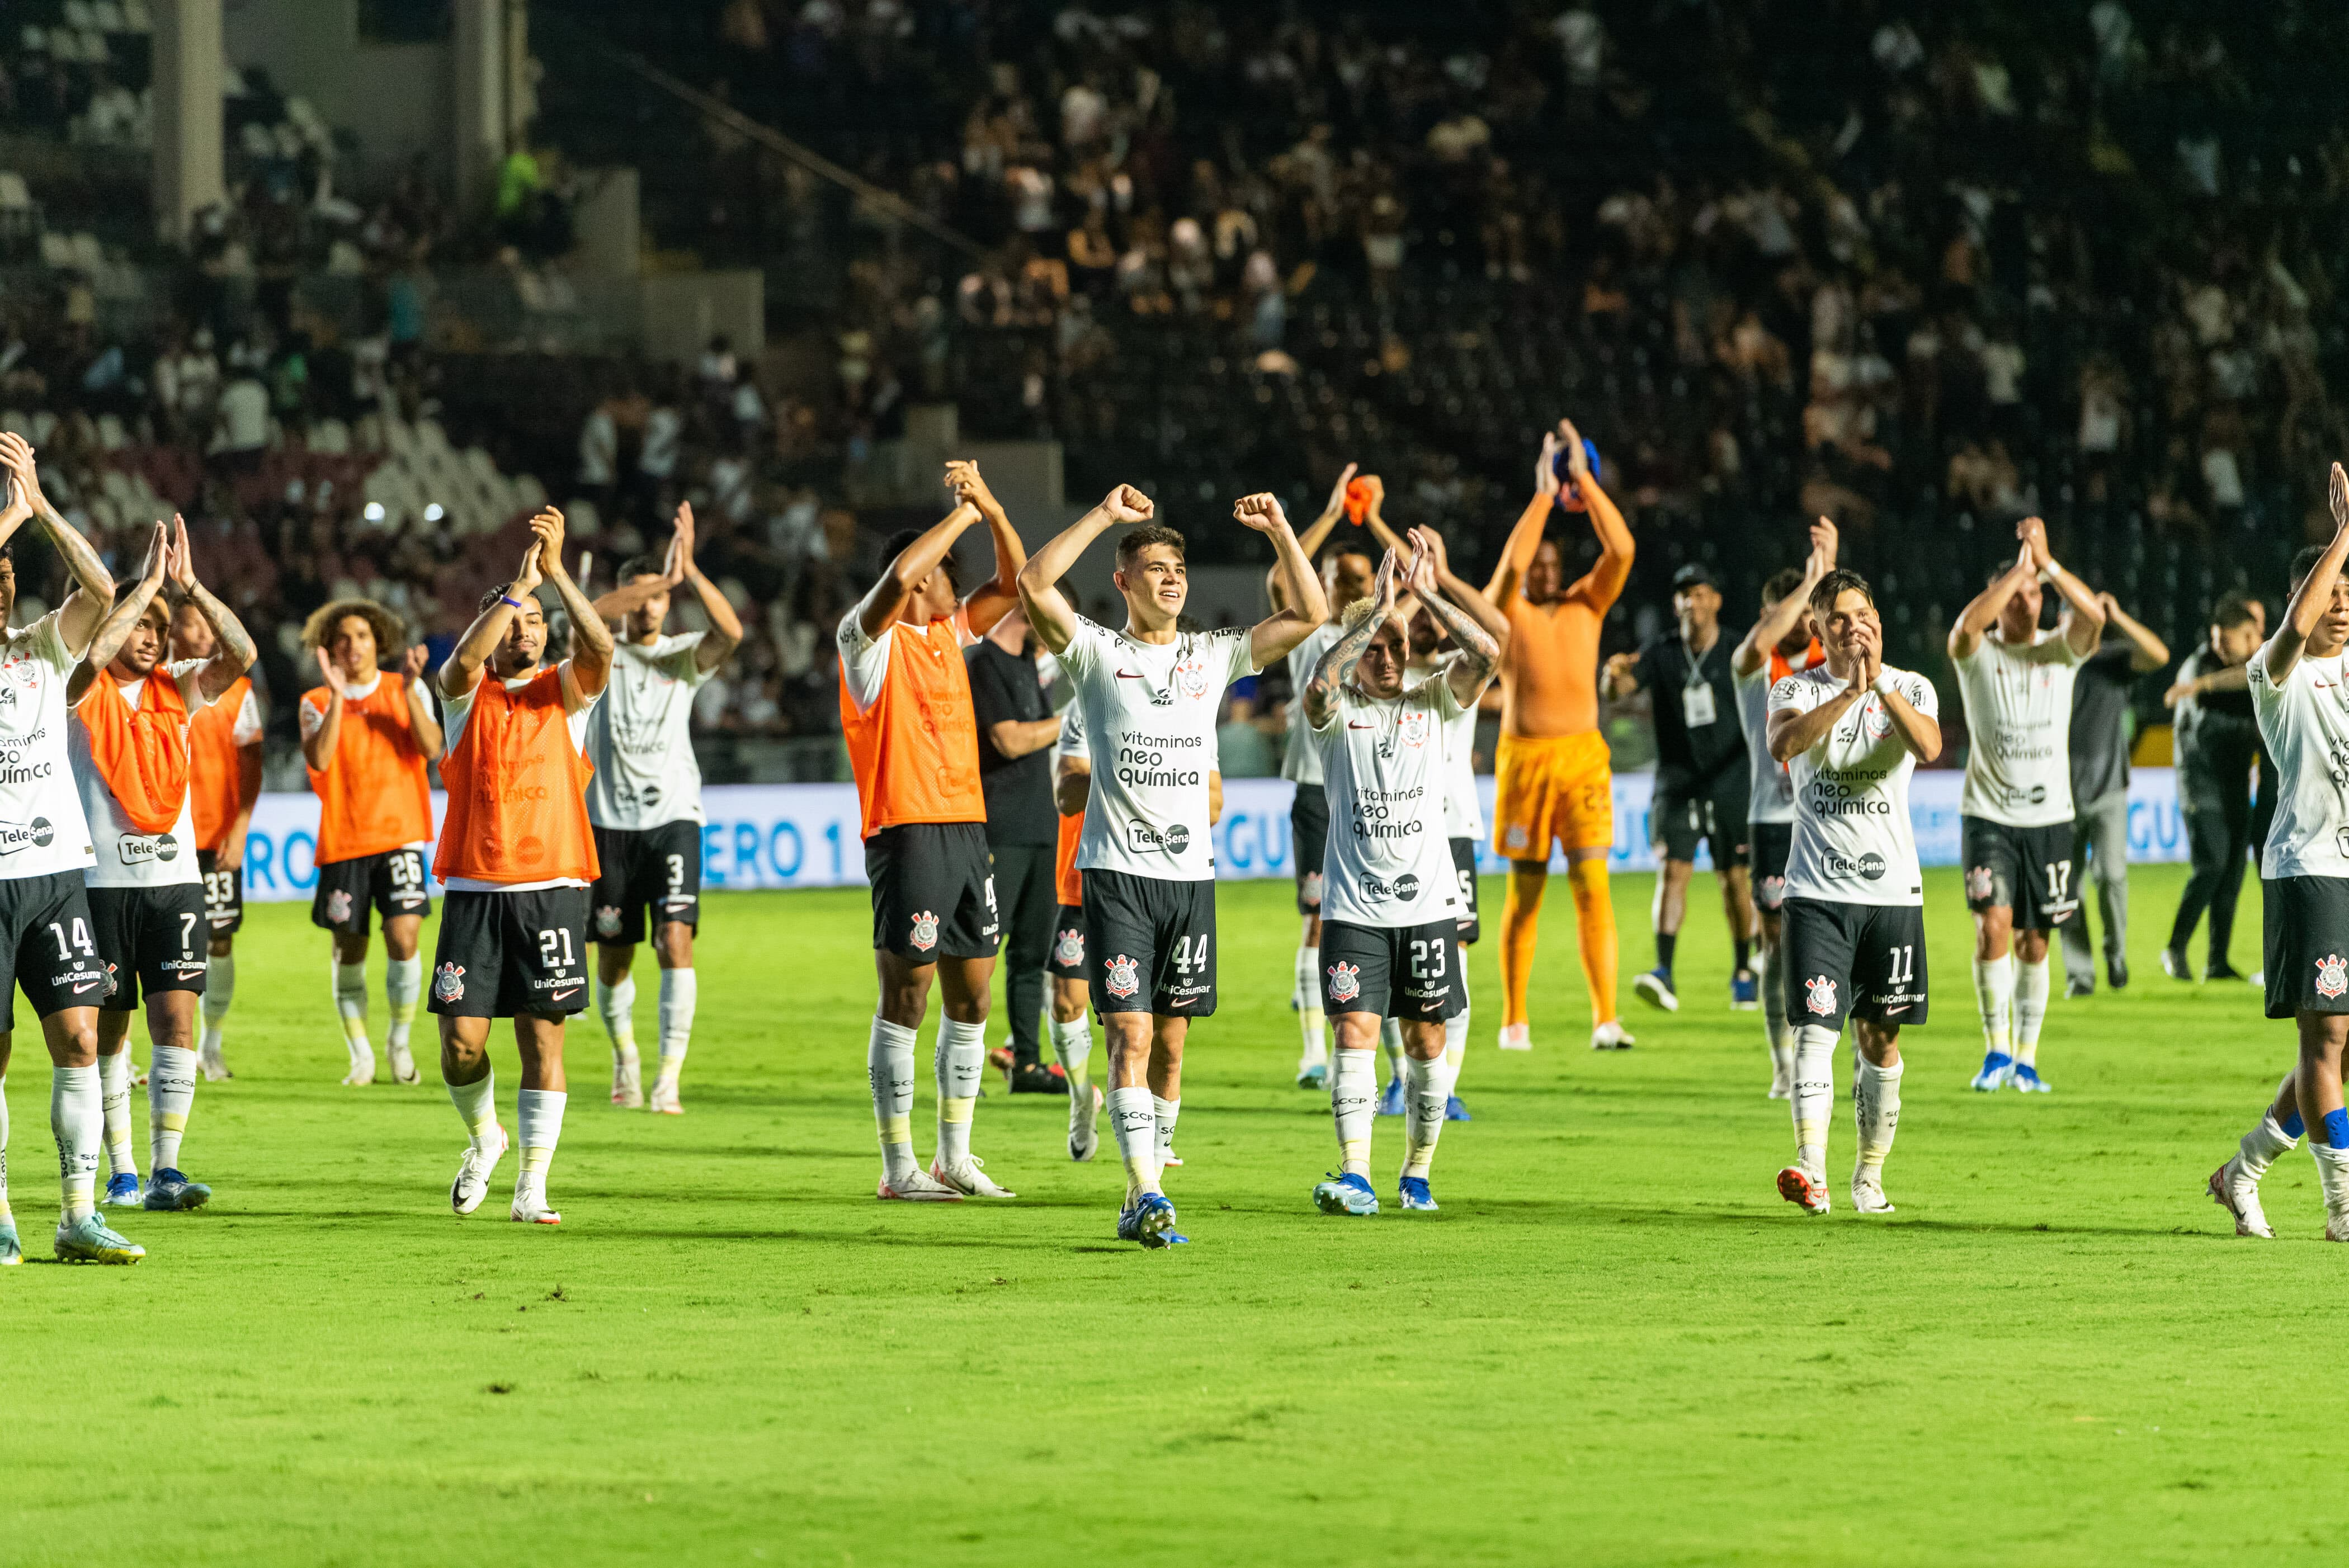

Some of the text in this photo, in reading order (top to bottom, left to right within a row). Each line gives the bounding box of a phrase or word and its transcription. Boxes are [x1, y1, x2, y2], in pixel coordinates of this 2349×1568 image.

[1121, 731, 1202, 748] vitaminas
[1120, 748, 1163, 767] neo
[1119, 767, 1199, 788] química
[1814, 768, 1887, 781] vitaminas
[1814, 782, 1851, 797] neo
[1352, 802, 1389, 819] neo
[1814, 798, 1890, 819] química
[1134, 829, 1163, 844] Tele
[1353, 820, 1422, 840] química
[125, 842, 153, 855] Tele
[389, 852, 422, 885] 26
[667, 854, 683, 886] 3
[1829, 857, 1856, 871] Tele
[204, 871, 234, 904] 33
[2046, 860, 2072, 897] 17
[1365, 881, 1392, 895] Tele
[49, 917, 95, 961] 14
[180, 912, 196, 950] 7
[539, 928, 576, 968] 21
[1172, 934, 1207, 974] 44
[1411, 938, 1446, 979] 23
[1888, 945, 1913, 984] 11
[1159, 983, 1211, 995] UniCesumar
[1404, 985, 1450, 998] UniCesumar
[1872, 993, 1925, 1004] UniCesumar
[1795, 1081, 1829, 1090] SCCP
[1332, 1098, 1367, 1108] SCCP
[1119, 1111, 1153, 1122] SCCP
